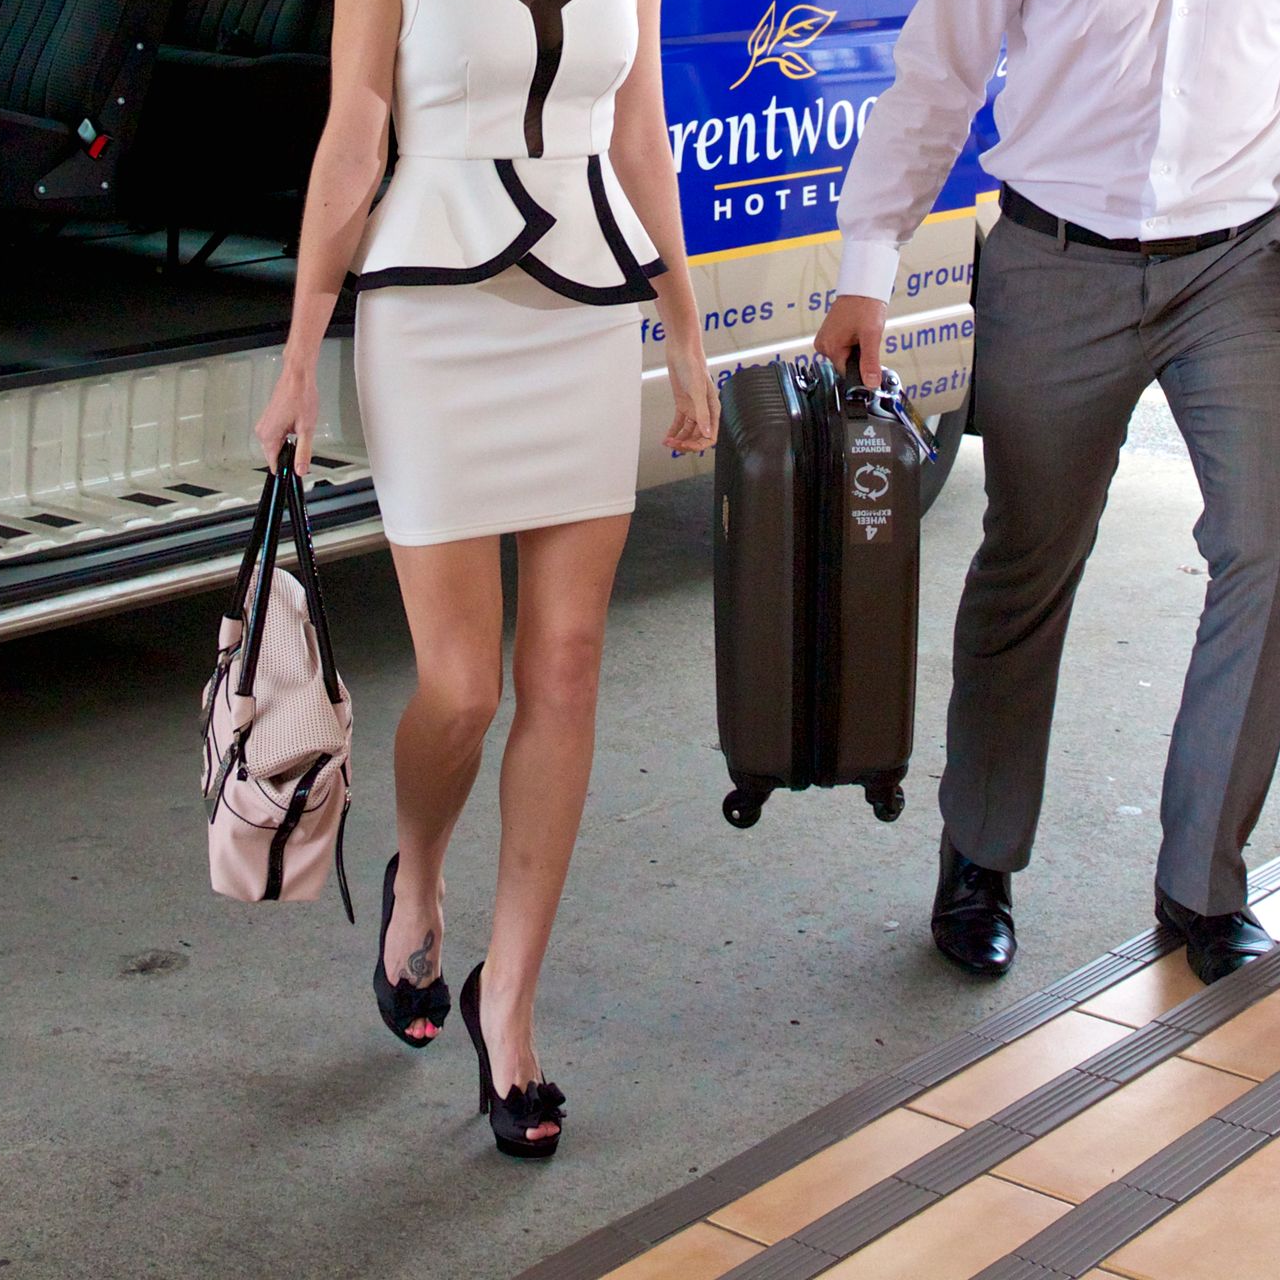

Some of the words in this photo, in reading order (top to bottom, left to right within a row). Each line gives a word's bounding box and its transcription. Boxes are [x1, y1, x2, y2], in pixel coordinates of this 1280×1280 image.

[713, 181, 840, 221] HOTEL
[863, 425, 876, 437] 4
[856, 516, 887, 525] WHEEL
[865, 525, 878, 540] 4
